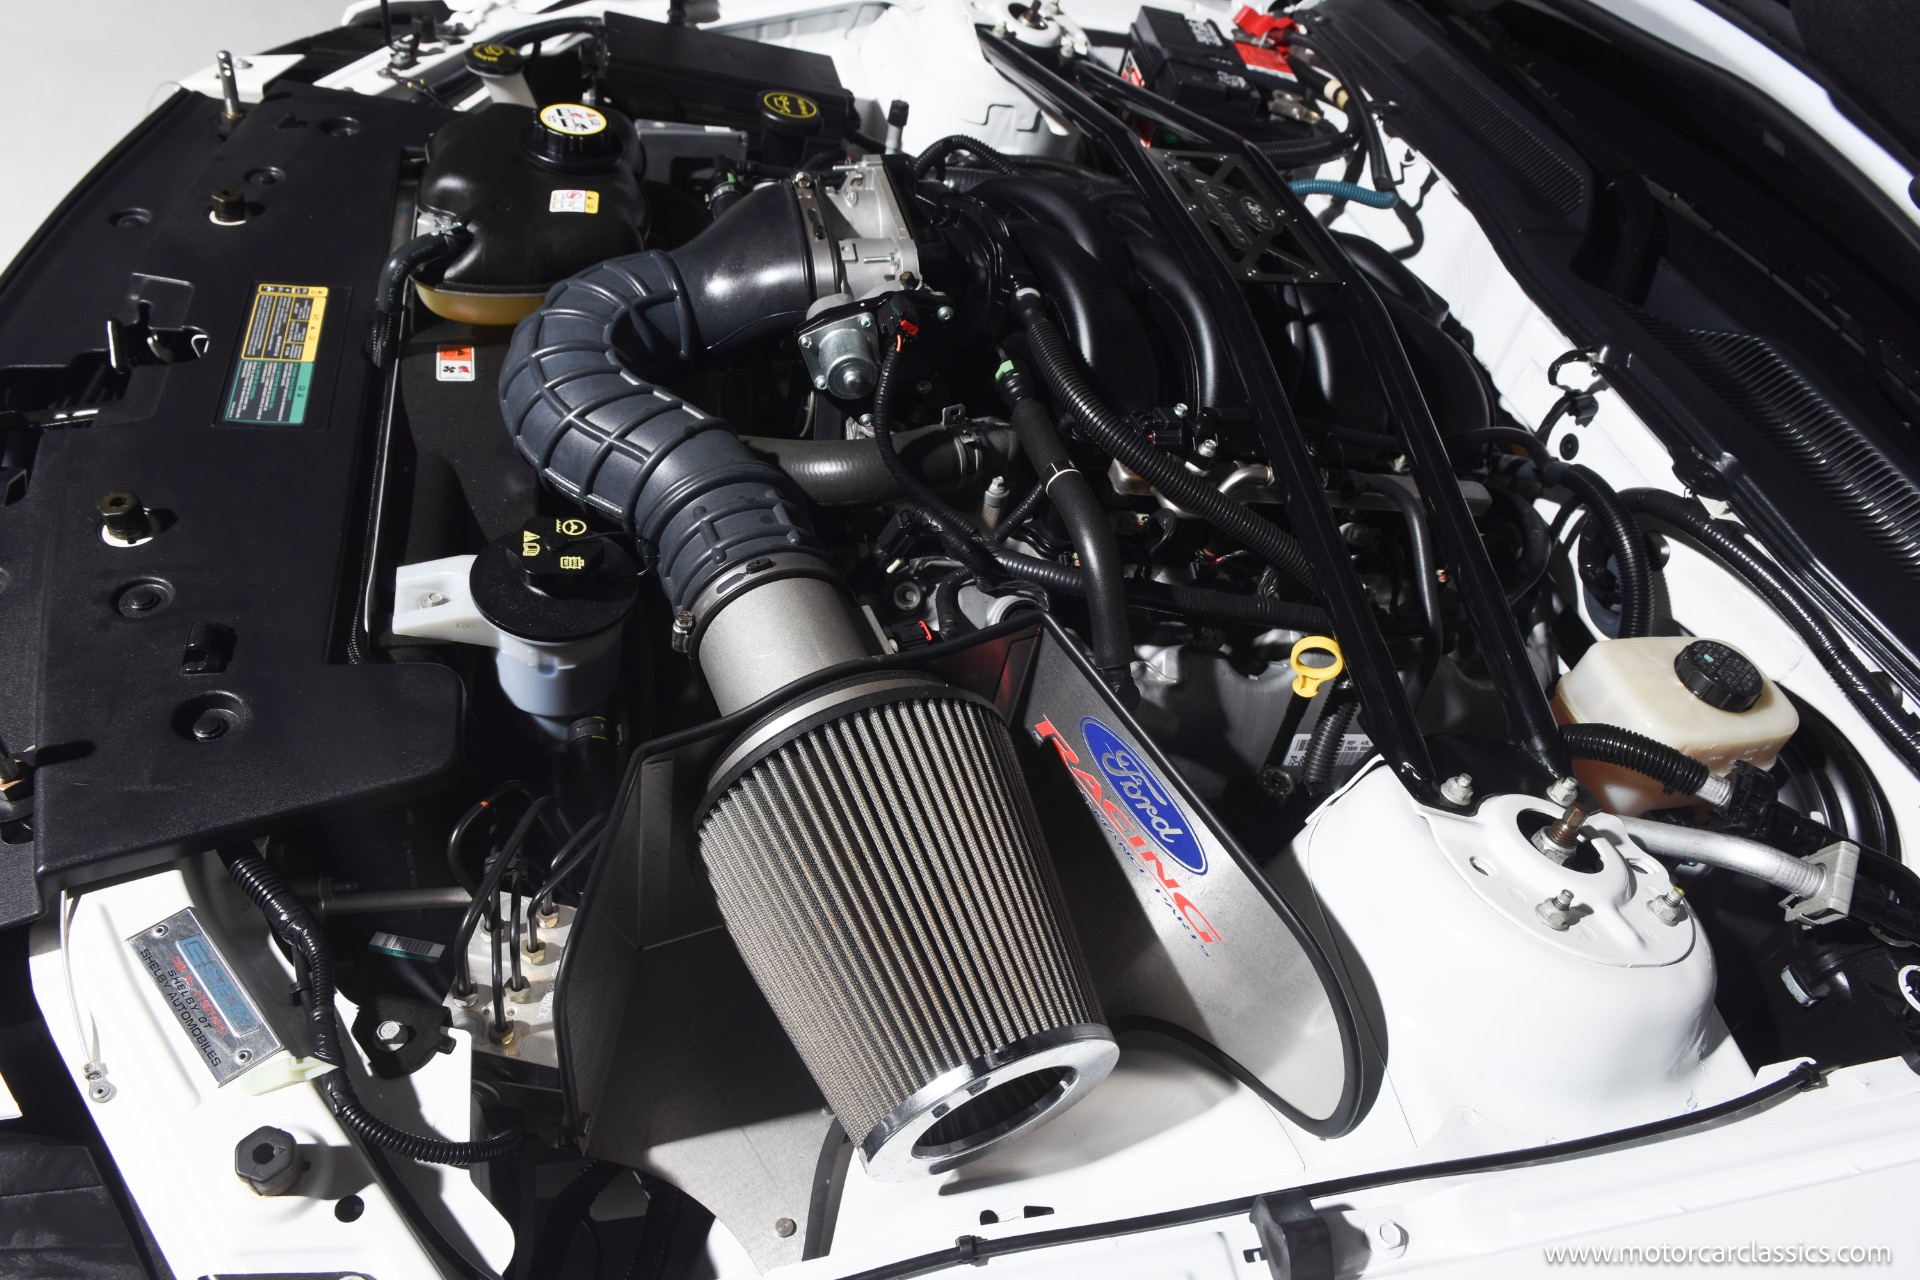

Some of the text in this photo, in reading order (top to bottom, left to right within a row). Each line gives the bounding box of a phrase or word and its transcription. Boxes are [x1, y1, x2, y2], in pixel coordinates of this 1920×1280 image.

[1035, 714, 1223, 942] RACING
[1102, 742, 1183, 843] Ford
[140, 949, 172, 988] SHELBY
[168, 992, 222, 1068] AUTOMOBILES
[168, 969, 199, 1010] SHELBY
[198, 1016, 212, 1029] GT
